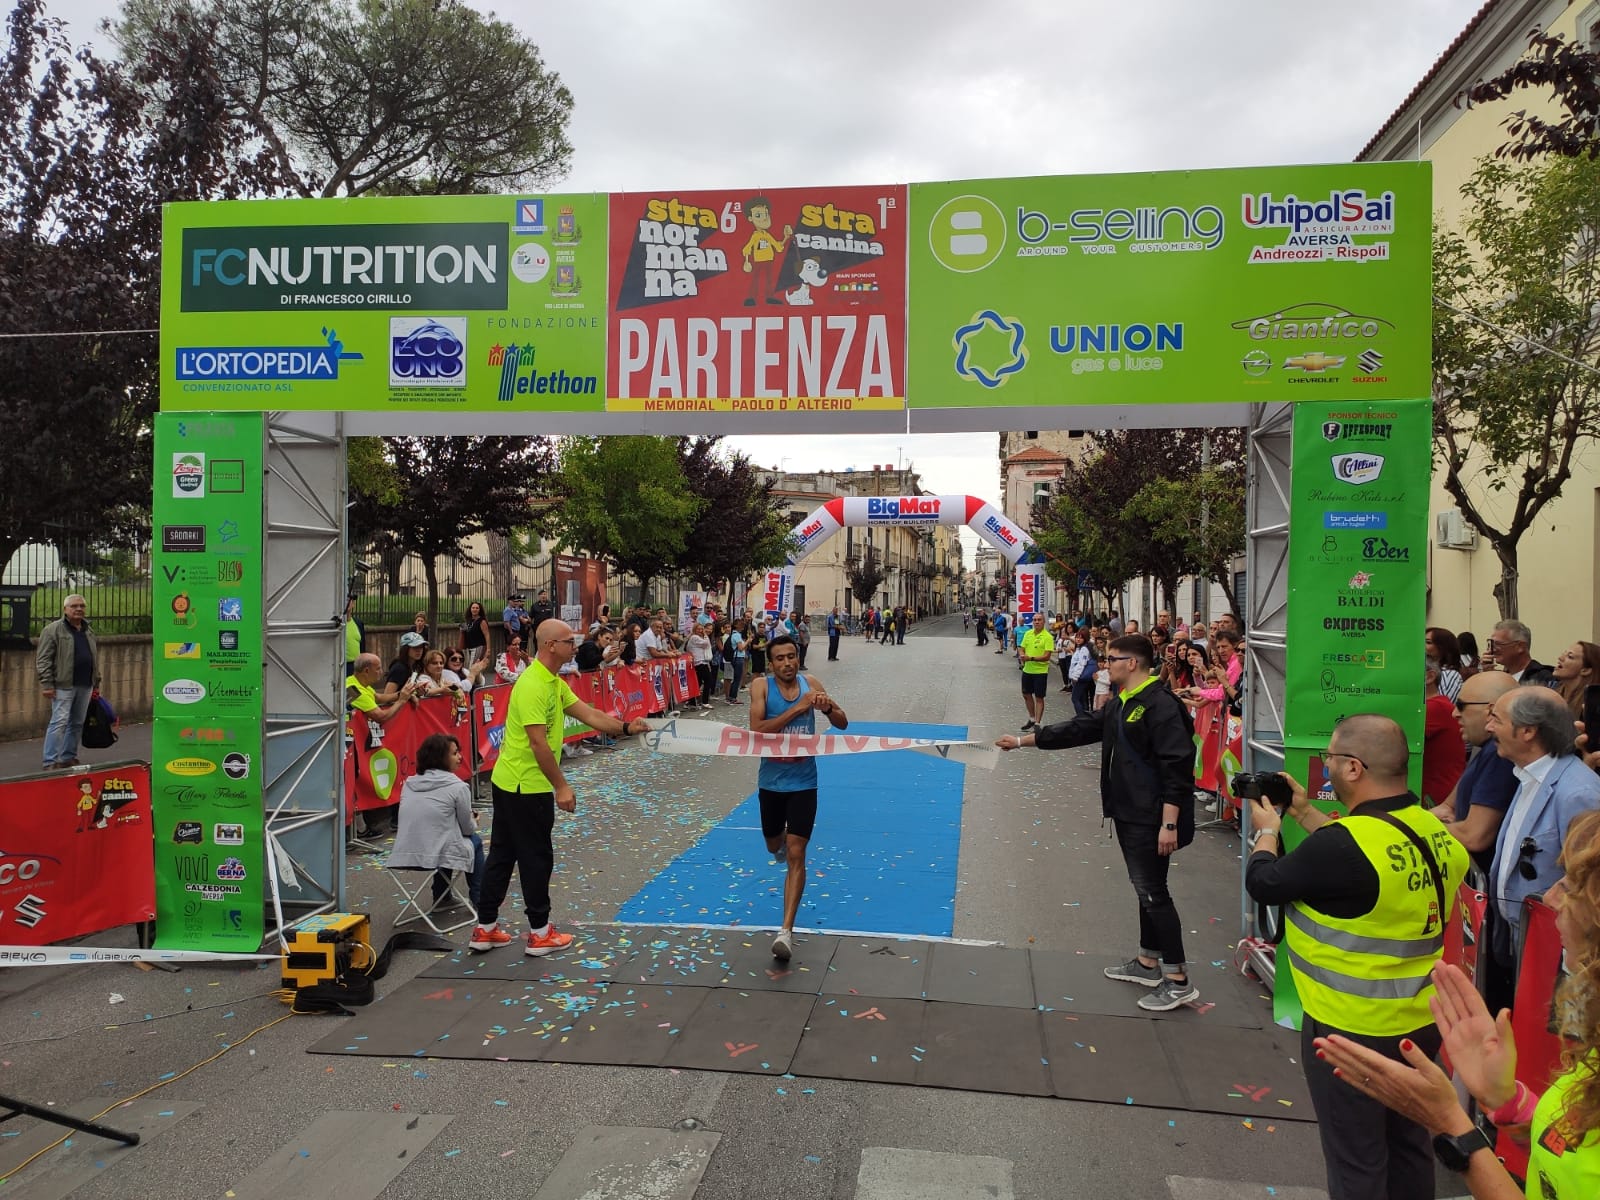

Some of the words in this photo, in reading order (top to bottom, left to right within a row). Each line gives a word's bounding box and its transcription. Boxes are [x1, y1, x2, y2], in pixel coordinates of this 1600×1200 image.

[647, 198, 719, 229] stra
[801, 203, 876, 235] stra
[1244, 191, 1393, 233] UnipolSai
[639, 219, 700, 246] nor
[1017, 205, 1225, 249] b-selling
[1304, 225, 1392, 234] ASSICURAZIONI
[795, 234, 884, 256] canina
[1017, 246, 1068, 256] AROUND
[1082, 245, 1116, 254] YOUR
[1129, 242, 1203, 253] CUSTOMERS
[1288, 234, 1350, 246] AVERSA
[645, 243, 728, 271] man
[1252, 247, 1323, 260] Andreozzi
[1336, 245, 1386, 260] Rispoli
[192, 245, 497, 286] FCNUTRITION
[644, 268, 698, 297] na
[280, 295, 292, 305] DI
[294, 295, 365, 305] FRANCESCO
[367, 294, 412, 304] CIRILLO
[487, 317, 600, 328] FONDAZIONE
[1248, 317, 1380, 341] Gianfico
[394, 337, 461, 356] ECO
[1049, 323, 1184, 353] UNION
[182, 352, 333, 375] L'ORTOPEDIA
[394, 356, 464, 376] UNO
[619, 315, 895, 400] PARTENZA
[1071, 358, 1105, 374] gas
[1108, 358, 1121, 371] e
[1124, 354, 1163, 370] luce
[183, 384, 271, 392] CONVENZIONATO
[275, 384, 293, 392] ASL
[645, 400, 715, 411] MEMORIAL
[732, 399, 774, 411] PAOLO
[797, 398, 853, 410] ALTERIO
[868, 497, 941, 520] BigMat
[983, 515, 1018, 547] BigMat
[1338, 596, 1385, 607] BALDI
[1323, 617, 1385, 631] express
[104, 777, 134, 791] stra
[102, 790, 138, 801] canina
[217, 869, 245, 877] BERNA
[1407, 862, 1449, 892] GAA
[185, 883, 241, 893] CALZEDONIA
[202, 892, 224, 900] AVERSA
